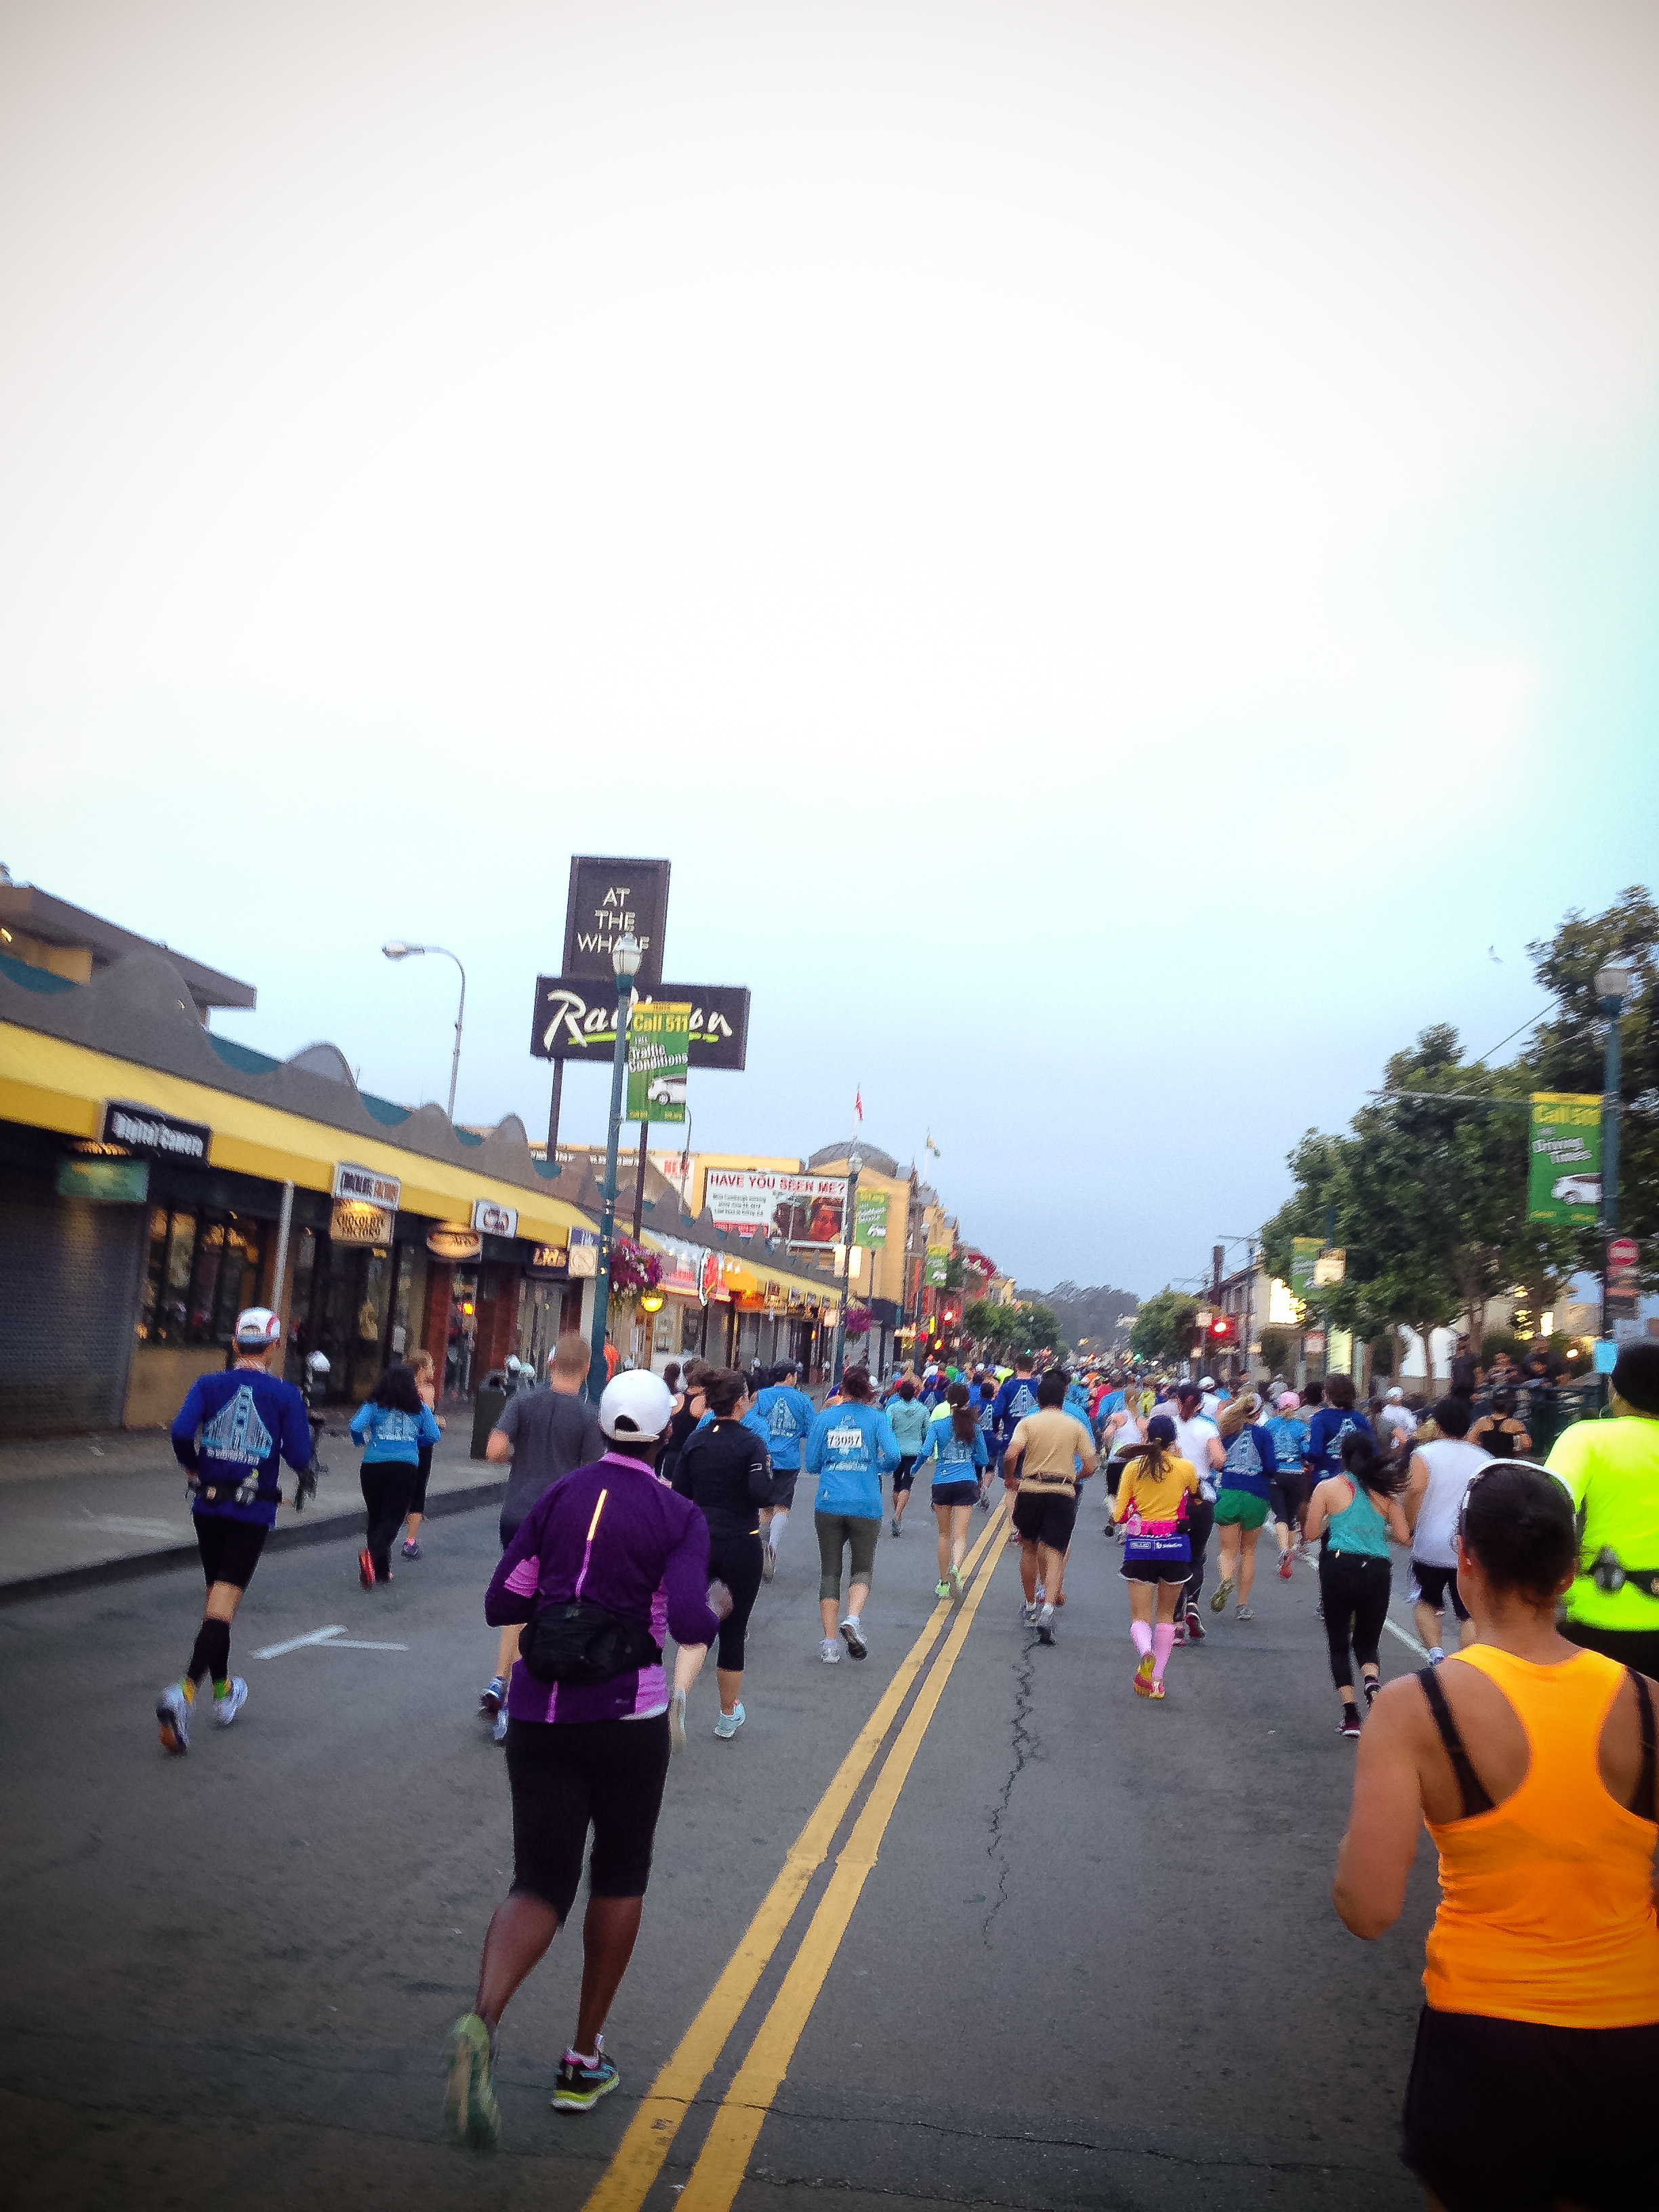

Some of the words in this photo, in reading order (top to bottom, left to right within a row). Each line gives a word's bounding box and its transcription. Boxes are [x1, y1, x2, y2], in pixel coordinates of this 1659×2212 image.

[602, 886, 631, 907] AT
[594, 909, 636, 931] THE
[577, 933, 650, 954] WHAF
[543, 986, 733, 1052] Radon
[633, 1014, 662, 1033] Call
[665, 1014, 689, 1033] 511
[630, 1043, 666, 1060] Traffic
[629, 1052, 689, 1073] Conditions
[710, 1173, 744, 1187] HAVE
[748, 1175, 775, 1189] YOU
[779, 1178, 813, 1193] SEEN
[817, 1181, 846, 1195] ME?
